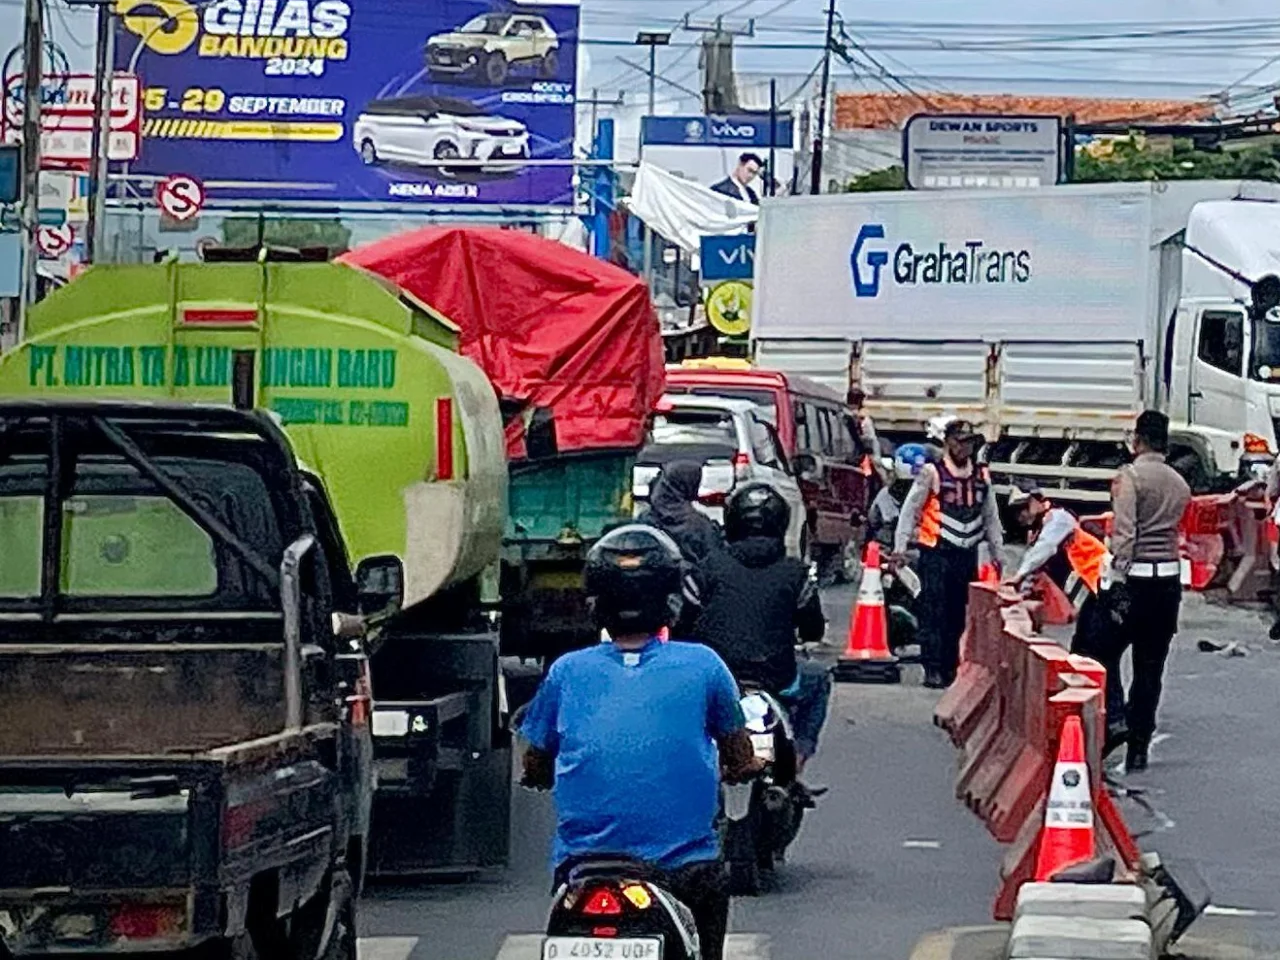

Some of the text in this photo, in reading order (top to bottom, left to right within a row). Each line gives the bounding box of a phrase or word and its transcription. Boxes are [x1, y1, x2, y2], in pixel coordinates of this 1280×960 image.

[199, 35, 348, 60] BANDUNG
[265, 58, 324, 76] 2024
[181, 90, 225, 112] 29
[228, 97, 346, 115] SEPTEMBER
[712, 124, 755, 137] vivo
[930, 122, 1038, 133] DEWAN SPORTS
[894, 241, 1030, 284] GrahaTrans
[30, 345, 58, 386] PT.
[64, 345, 135, 386] MITRA
[337, 349, 396, 389] BARU
